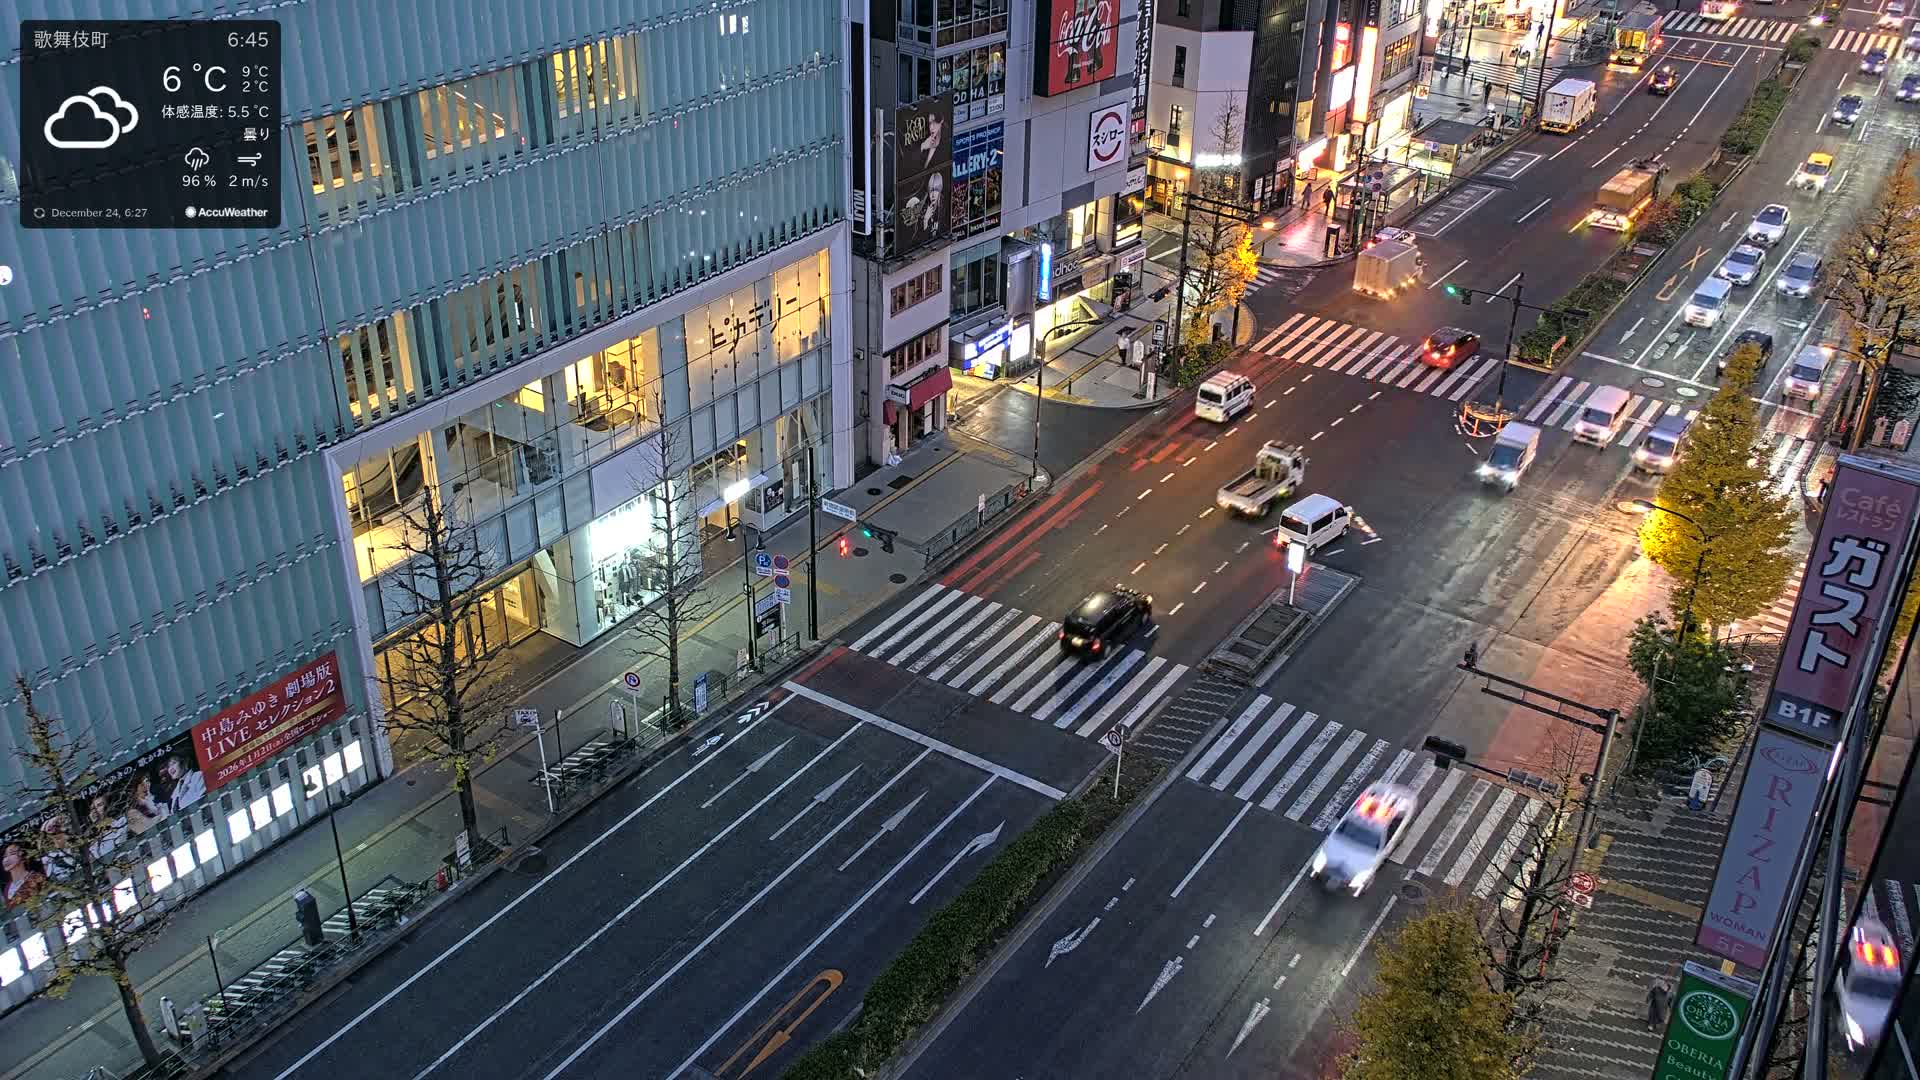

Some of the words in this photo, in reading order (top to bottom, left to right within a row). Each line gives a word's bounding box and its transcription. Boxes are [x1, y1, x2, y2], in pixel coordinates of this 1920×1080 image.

[955, 134, 975, 146] SPORTS
[1092, 129, 1124, 147] スシロー
[853, 189, 865, 222] MUJI
[1052, 260, 1079, 278] dhoc
[711, 297, 797, 354] ピカデリー
[1840, 486, 1901, 518] Café
[1837, 505, 1898, 531] レストラン
[1801, 536, 1888, 672] ガスト
[202, 693, 279, 743] 中島みゆき
[1777, 700, 1831, 729] B1F
[206, 725, 252, 761] LIVE
[1729, 775, 1793, 914] RIZAP
[1710, 912, 1766, 940] WOMAN
[1667, 1039, 1723, 1070] OBERIA
